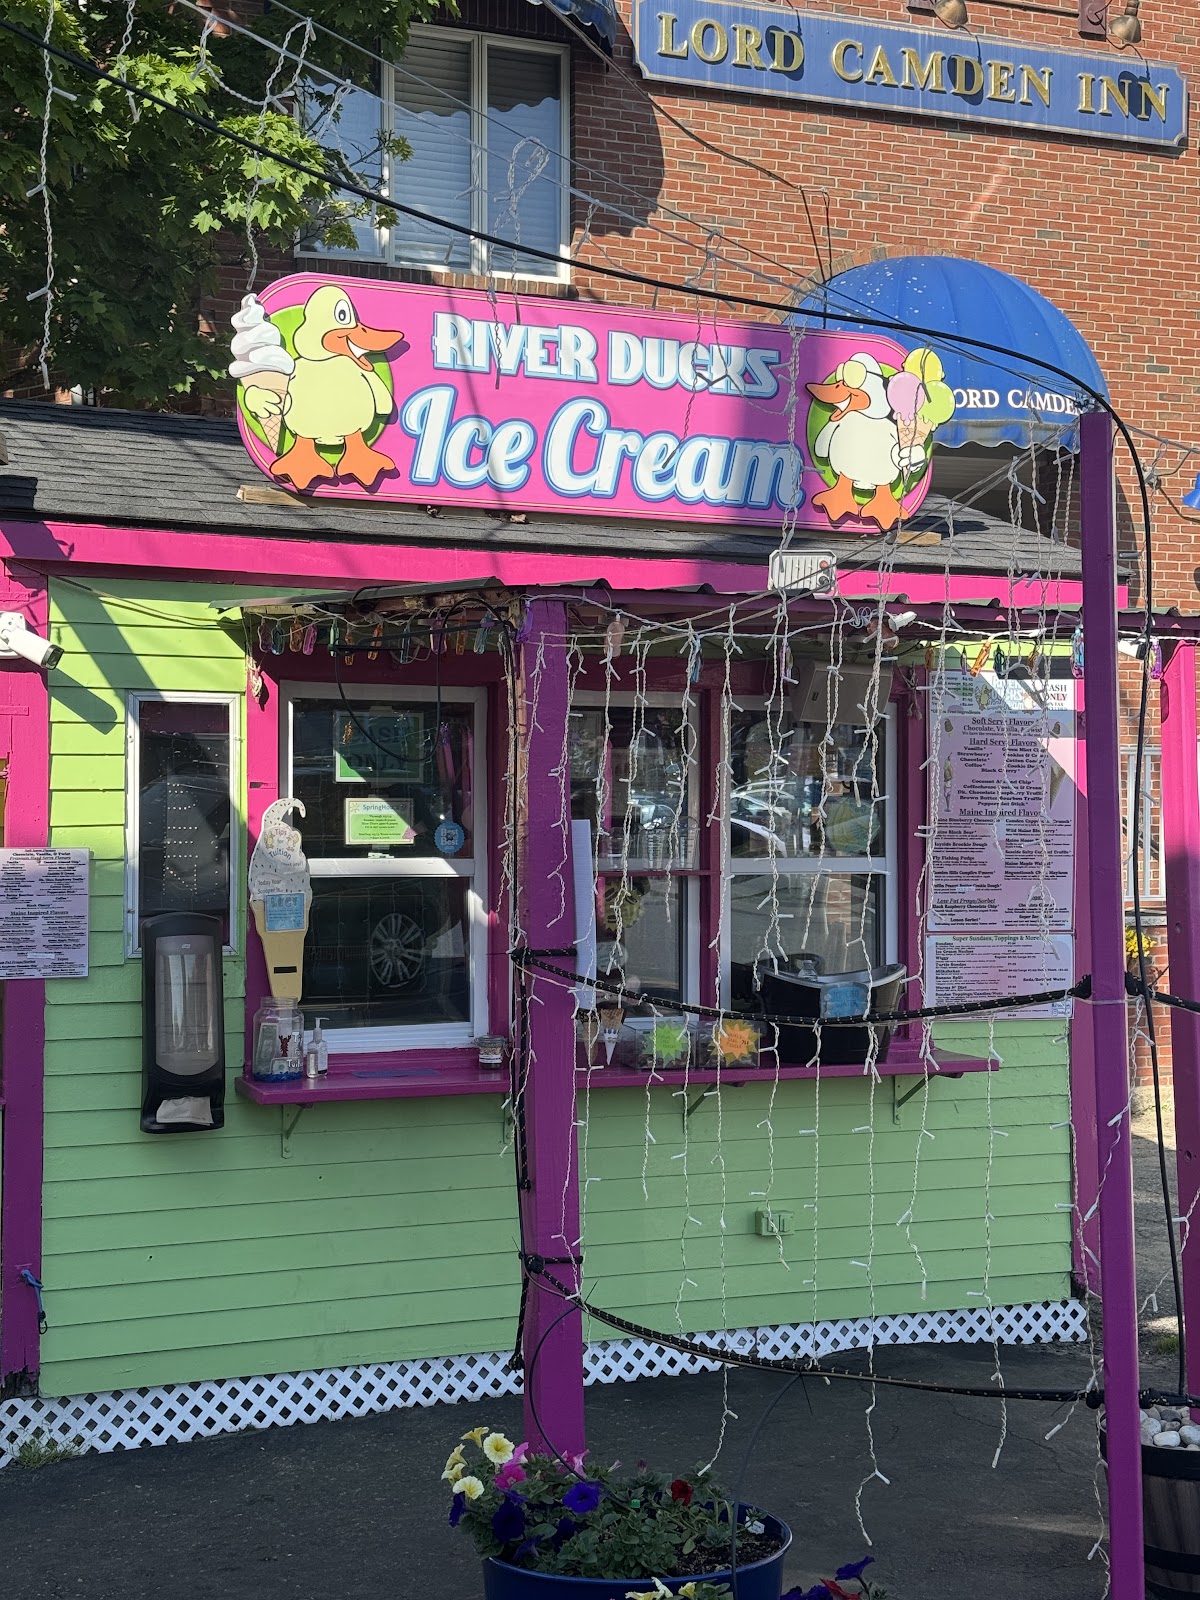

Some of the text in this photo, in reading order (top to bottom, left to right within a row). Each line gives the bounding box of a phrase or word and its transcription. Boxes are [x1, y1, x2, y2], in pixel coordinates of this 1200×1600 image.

[657, 13, 1171, 122] LORD CAMDEN INN
[432, 312, 781, 398] RIVER DUCKS
[953, 388, 1000, 409] ORD
[401, 383, 805, 509] Ice Cream
[1047, 684, 1067, 692] ASH
[972, 717, 986, 725] Soft
[959, 808, 983, 816] Maine
[441, 836, 458, 845] Best
[269, 848, 291, 860] Tuition
